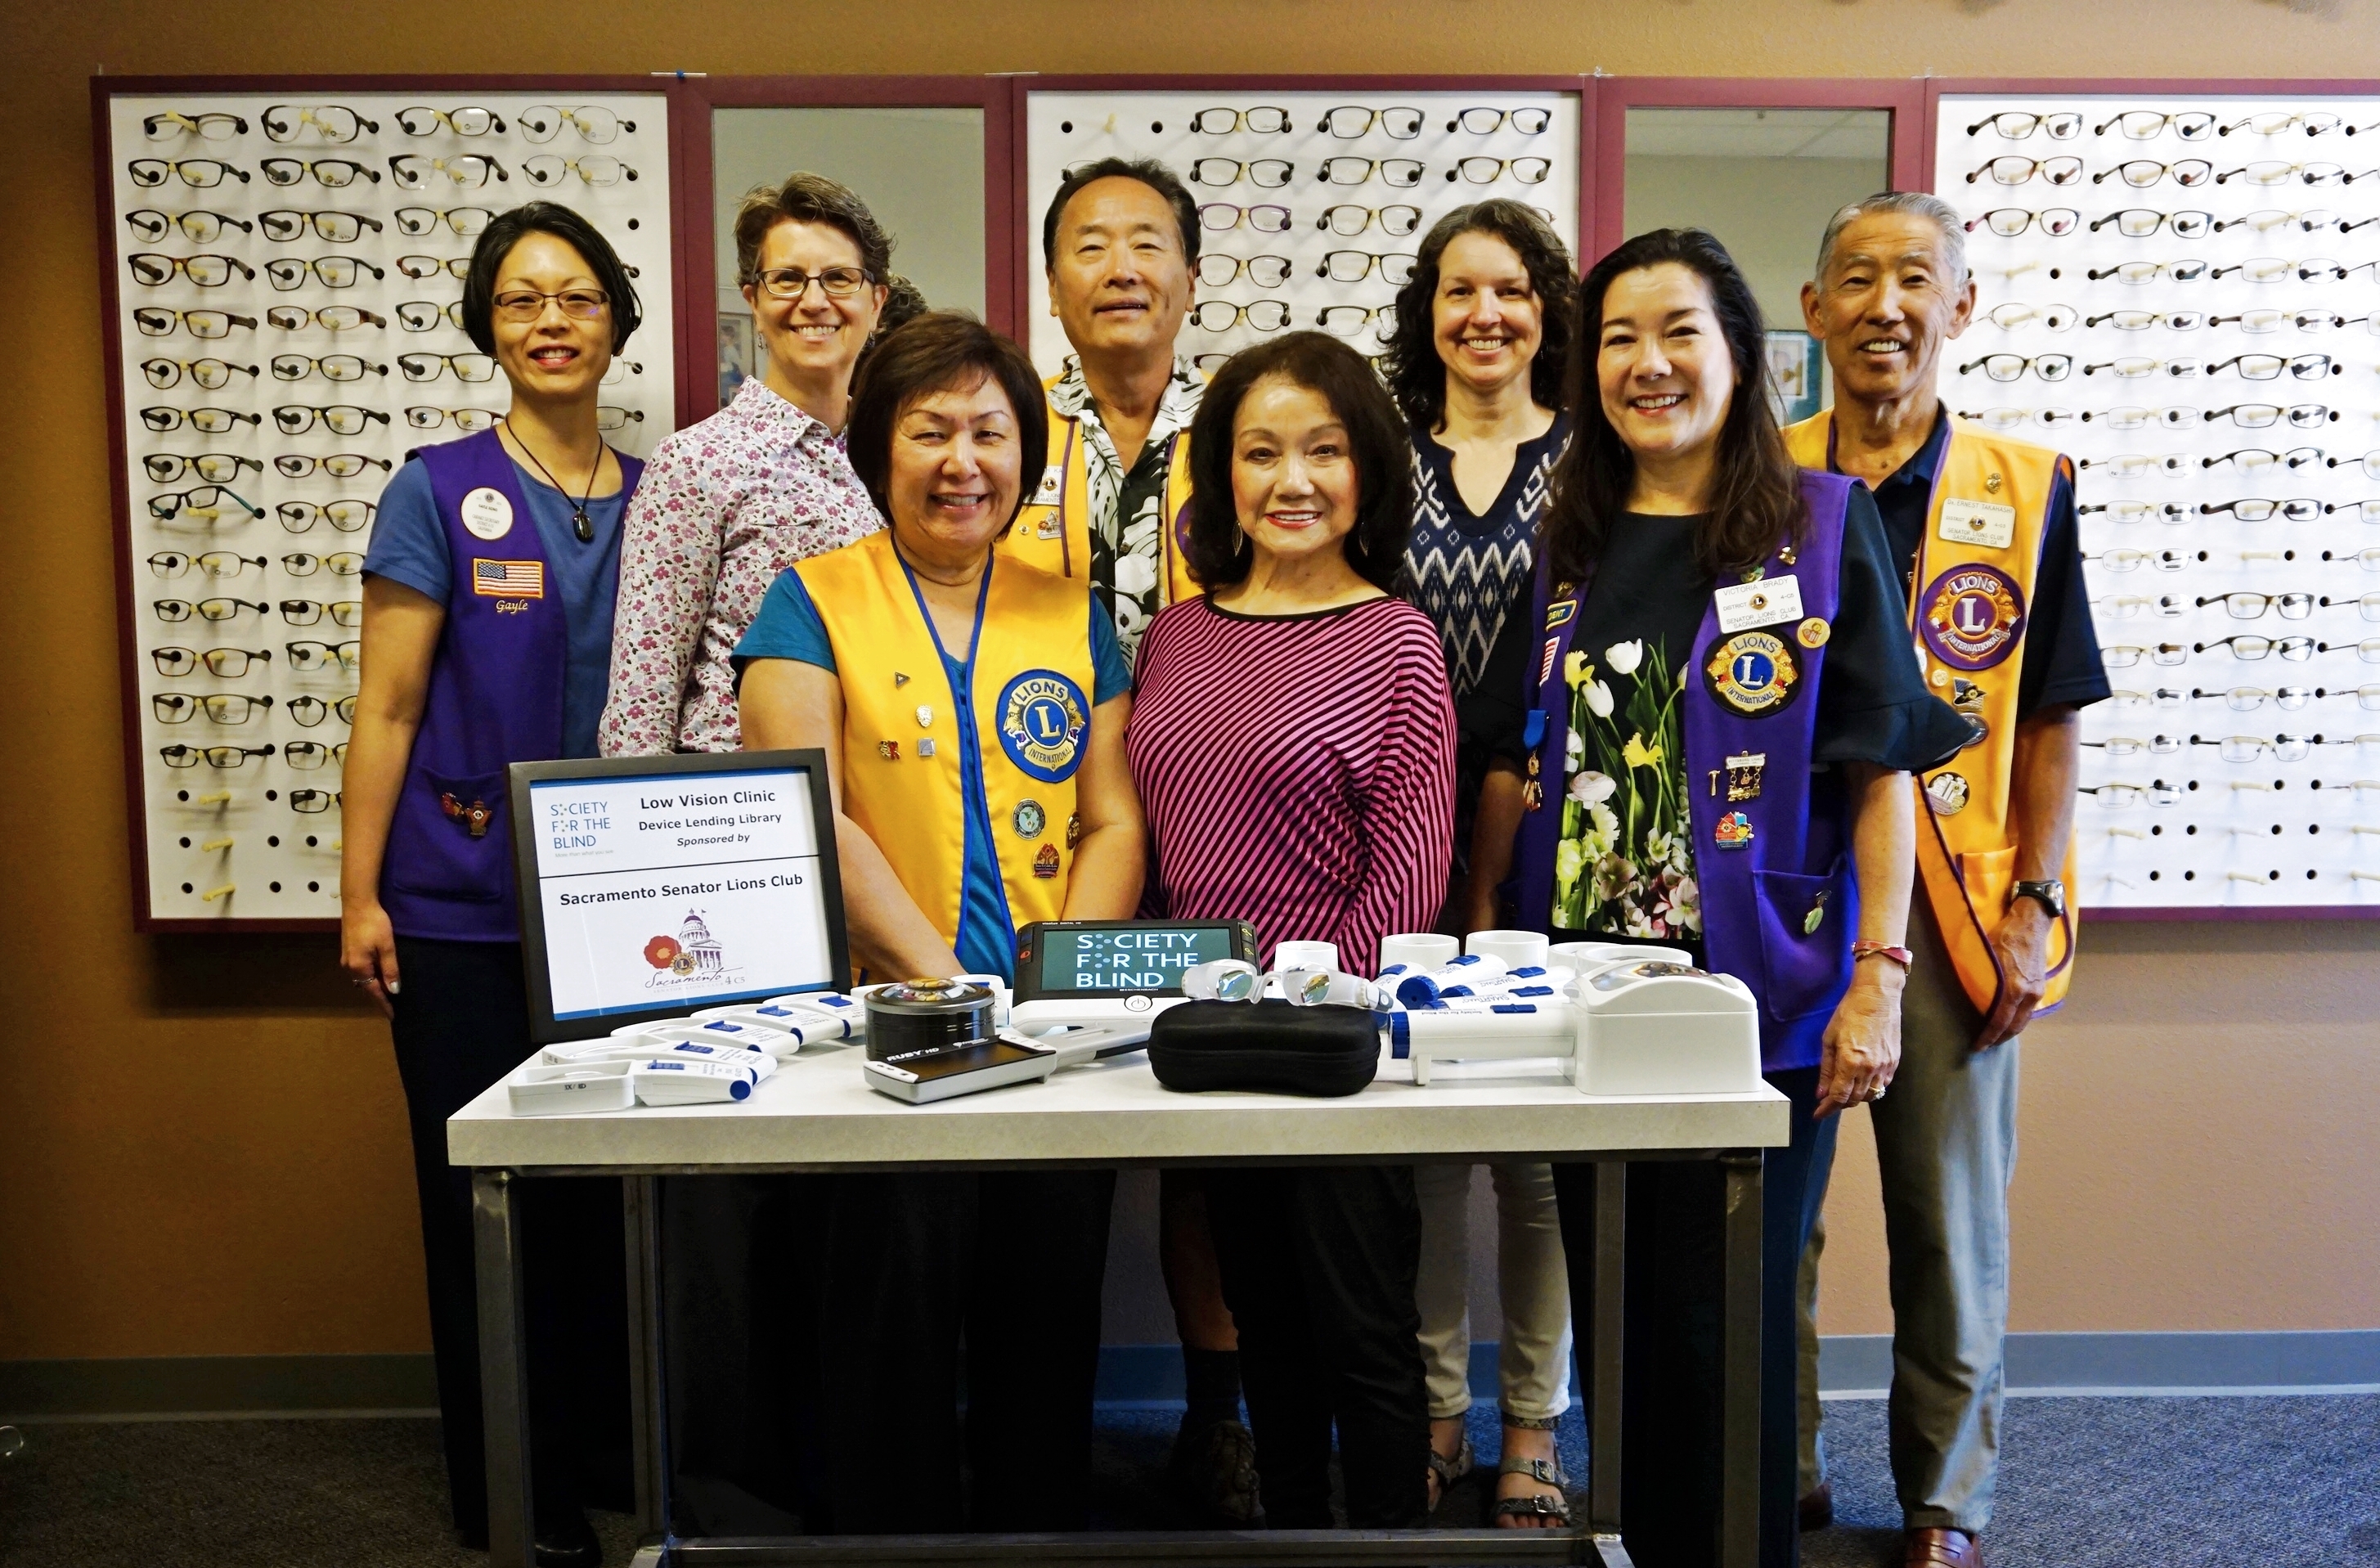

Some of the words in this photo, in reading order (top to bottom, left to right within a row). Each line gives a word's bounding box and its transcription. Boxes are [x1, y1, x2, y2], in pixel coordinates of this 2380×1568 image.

[1982, 503, 2013, 513] TAKAHASHI
[1722, 584, 1758, 596] VICTORIA
[1763, 577, 1789, 588] BRADY
[1950, 576, 1998, 594] LIONS
[496, 599, 528, 614] Gayle
[1723, 602, 1747, 611] DISTRICT
[1961, 597, 1986, 632] L
[1727, 614, 1754, 625] SENATOR
[1758, 610, 1776, 618] LIONS
[1733, 637, 1778, 654] LIONS
[1948, 634, 2001, 652] INTERNATIONAL
[1739, 656, 1763, 686] L
[1015, 681, 1065, 702] LIONS
[1727, 687, 1776, 704] INTERNATIONAL
[1035, 706, 1061, 738] L
[1028, 746, 1072, 763] INTERNATIONAL
[640, 797, 673, 810] Low
[679, 793, 728, 806] Vision
[734, 790, 775, 803] Clinic
[584, 818, 611, 830] THE
[639, 820, 681, 831] Device
[685, 816, 735, 828] Lending
[739, 814, 782, 824] Library
[554, 835, 596, 849] BLIND
[677, 834, 734, 847] Sponsored
[738, 833, 750, 842] by
[560, 887, 656, 905] Sacramento
[662, 883, 721, 896] Senator
[727, 878, 766, 891] Lions
[770, 874, 802, 887] Club
[1142, 953, 1198, 968] THE
[644, 967, 743, 988] Sacramento
[1076, 973, 1164, 988] BLIND
[887, 1049, 921, 1062] RUBY
